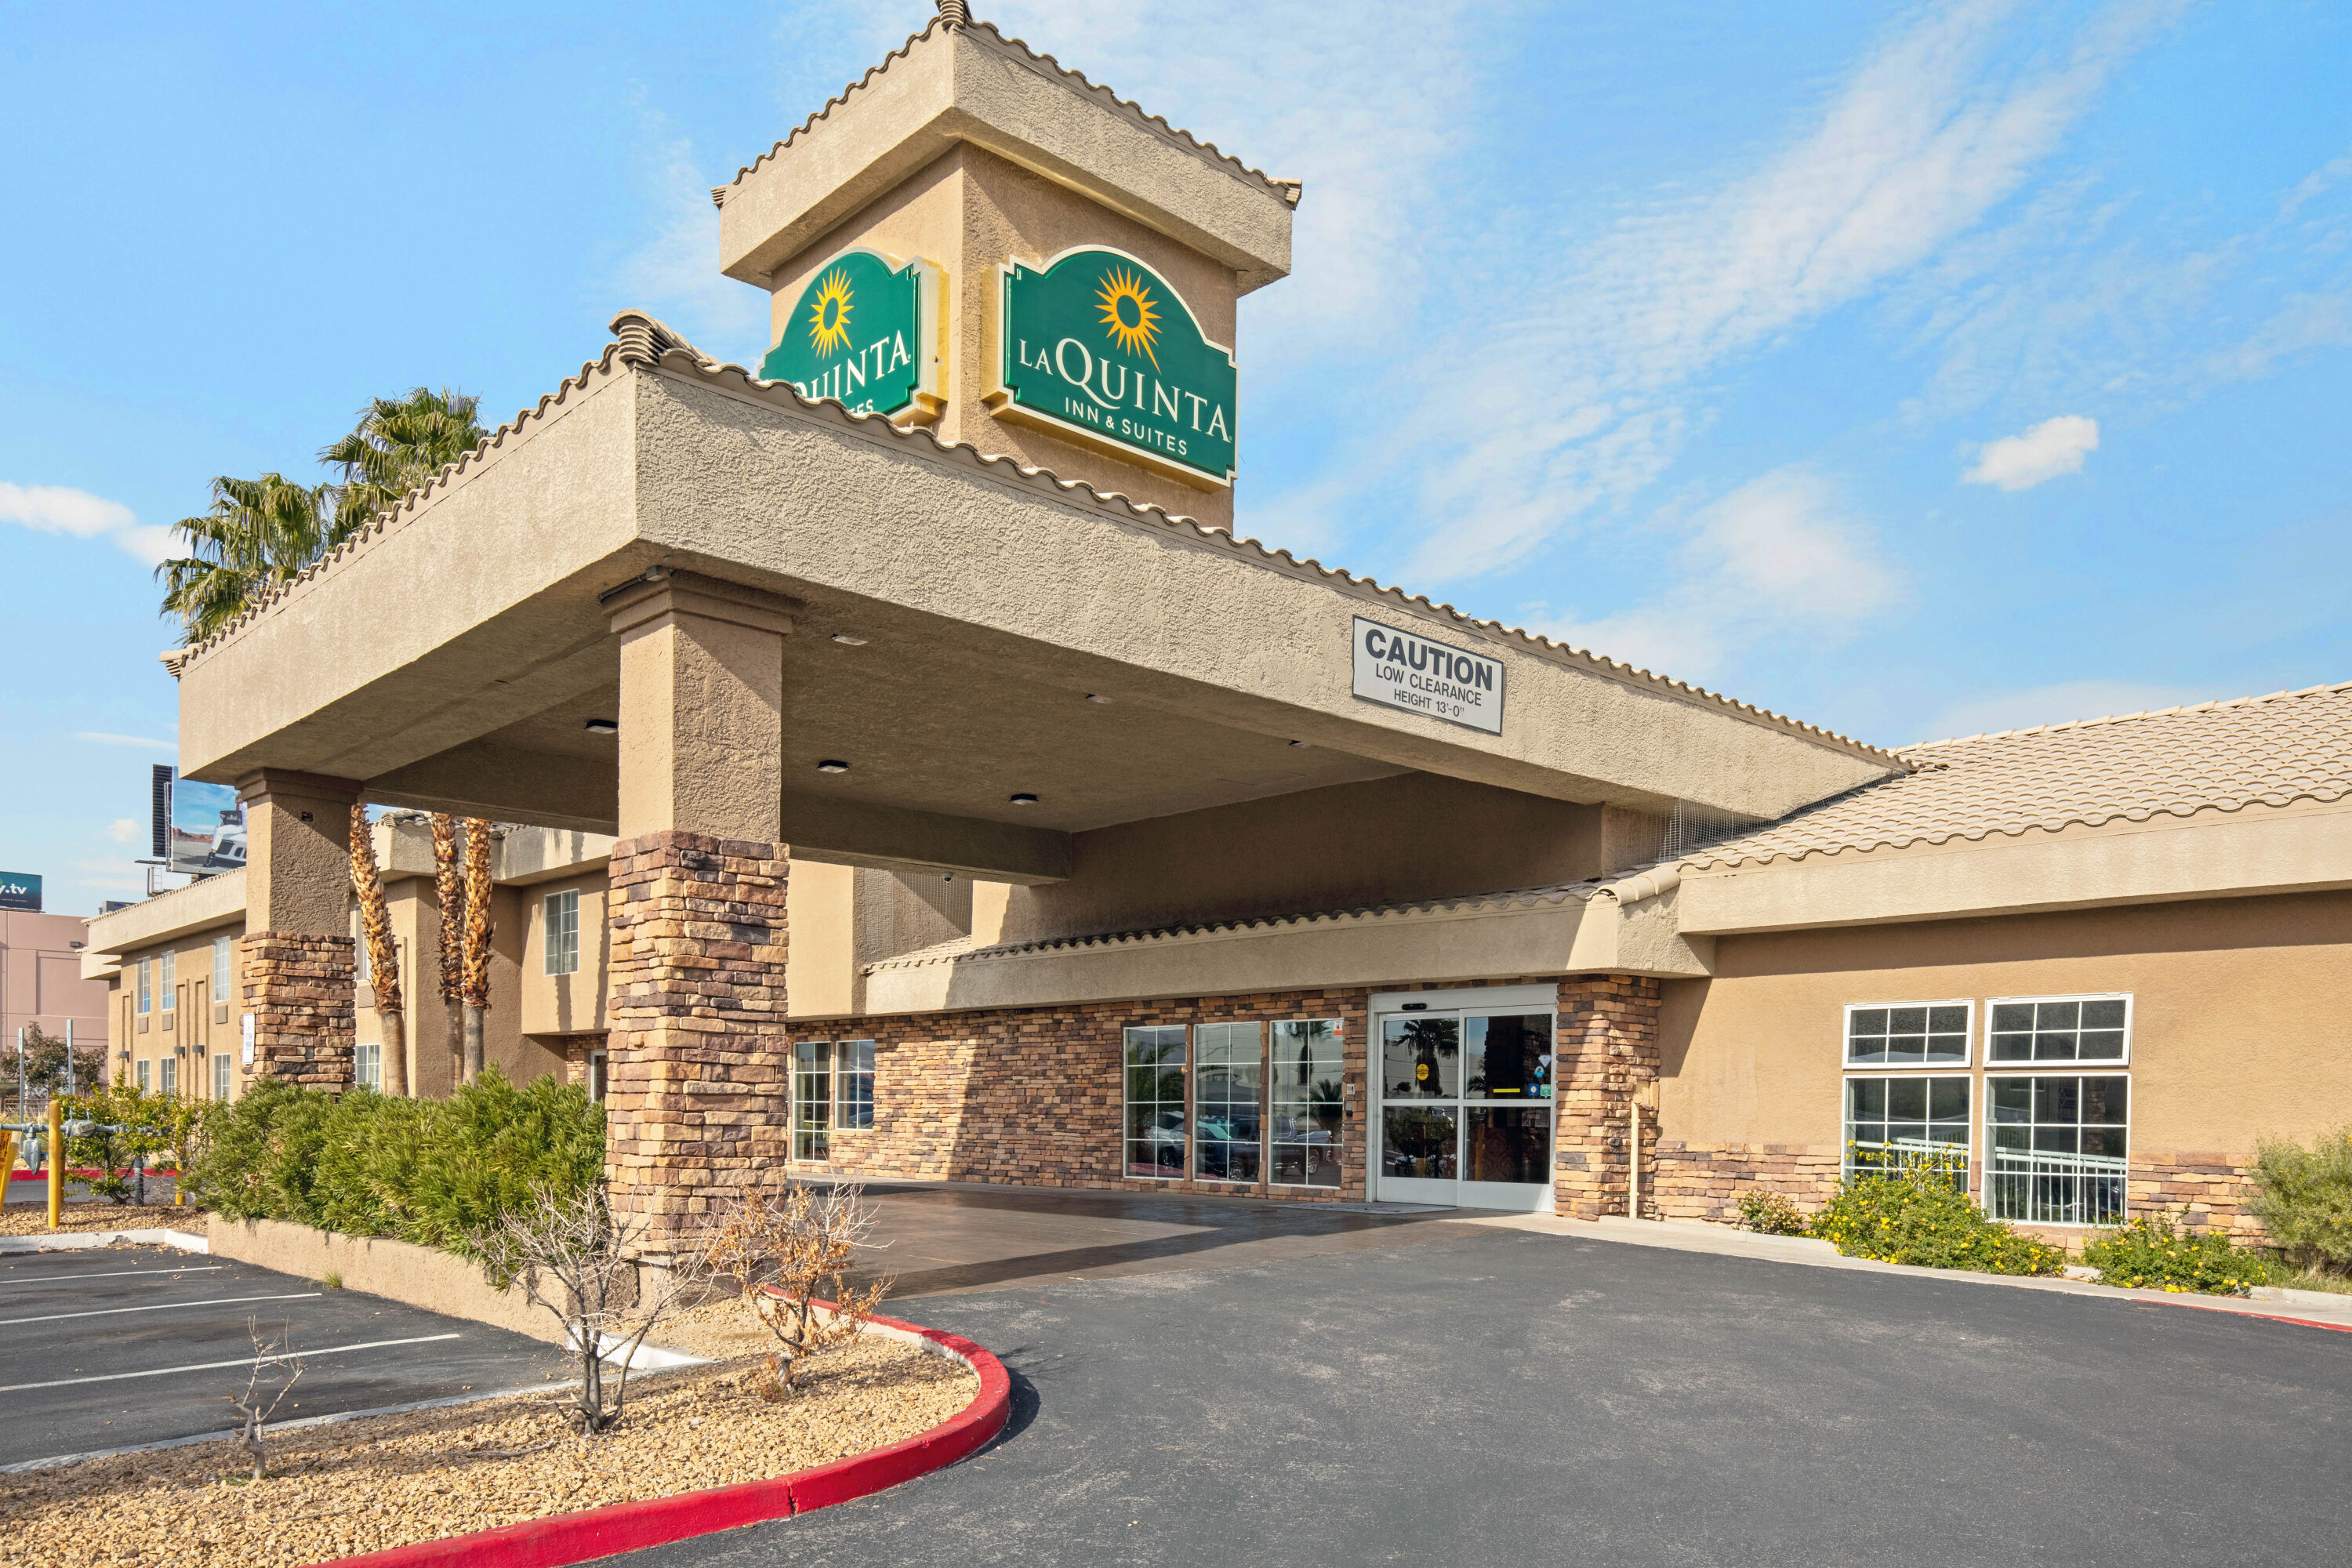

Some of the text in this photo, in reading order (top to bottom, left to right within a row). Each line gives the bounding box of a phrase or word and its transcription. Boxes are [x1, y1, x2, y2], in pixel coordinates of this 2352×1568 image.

[1019, 337, 1232, 444] LA QUINTA
[1065, 397, 1188, 456] INN & SUITES
[1365, 629, 1493, 691] CAUTION
[1376, 663, 1482, 706] LOW CLEARANCE
[1394, 688, 1432, 710] HEIGHT
